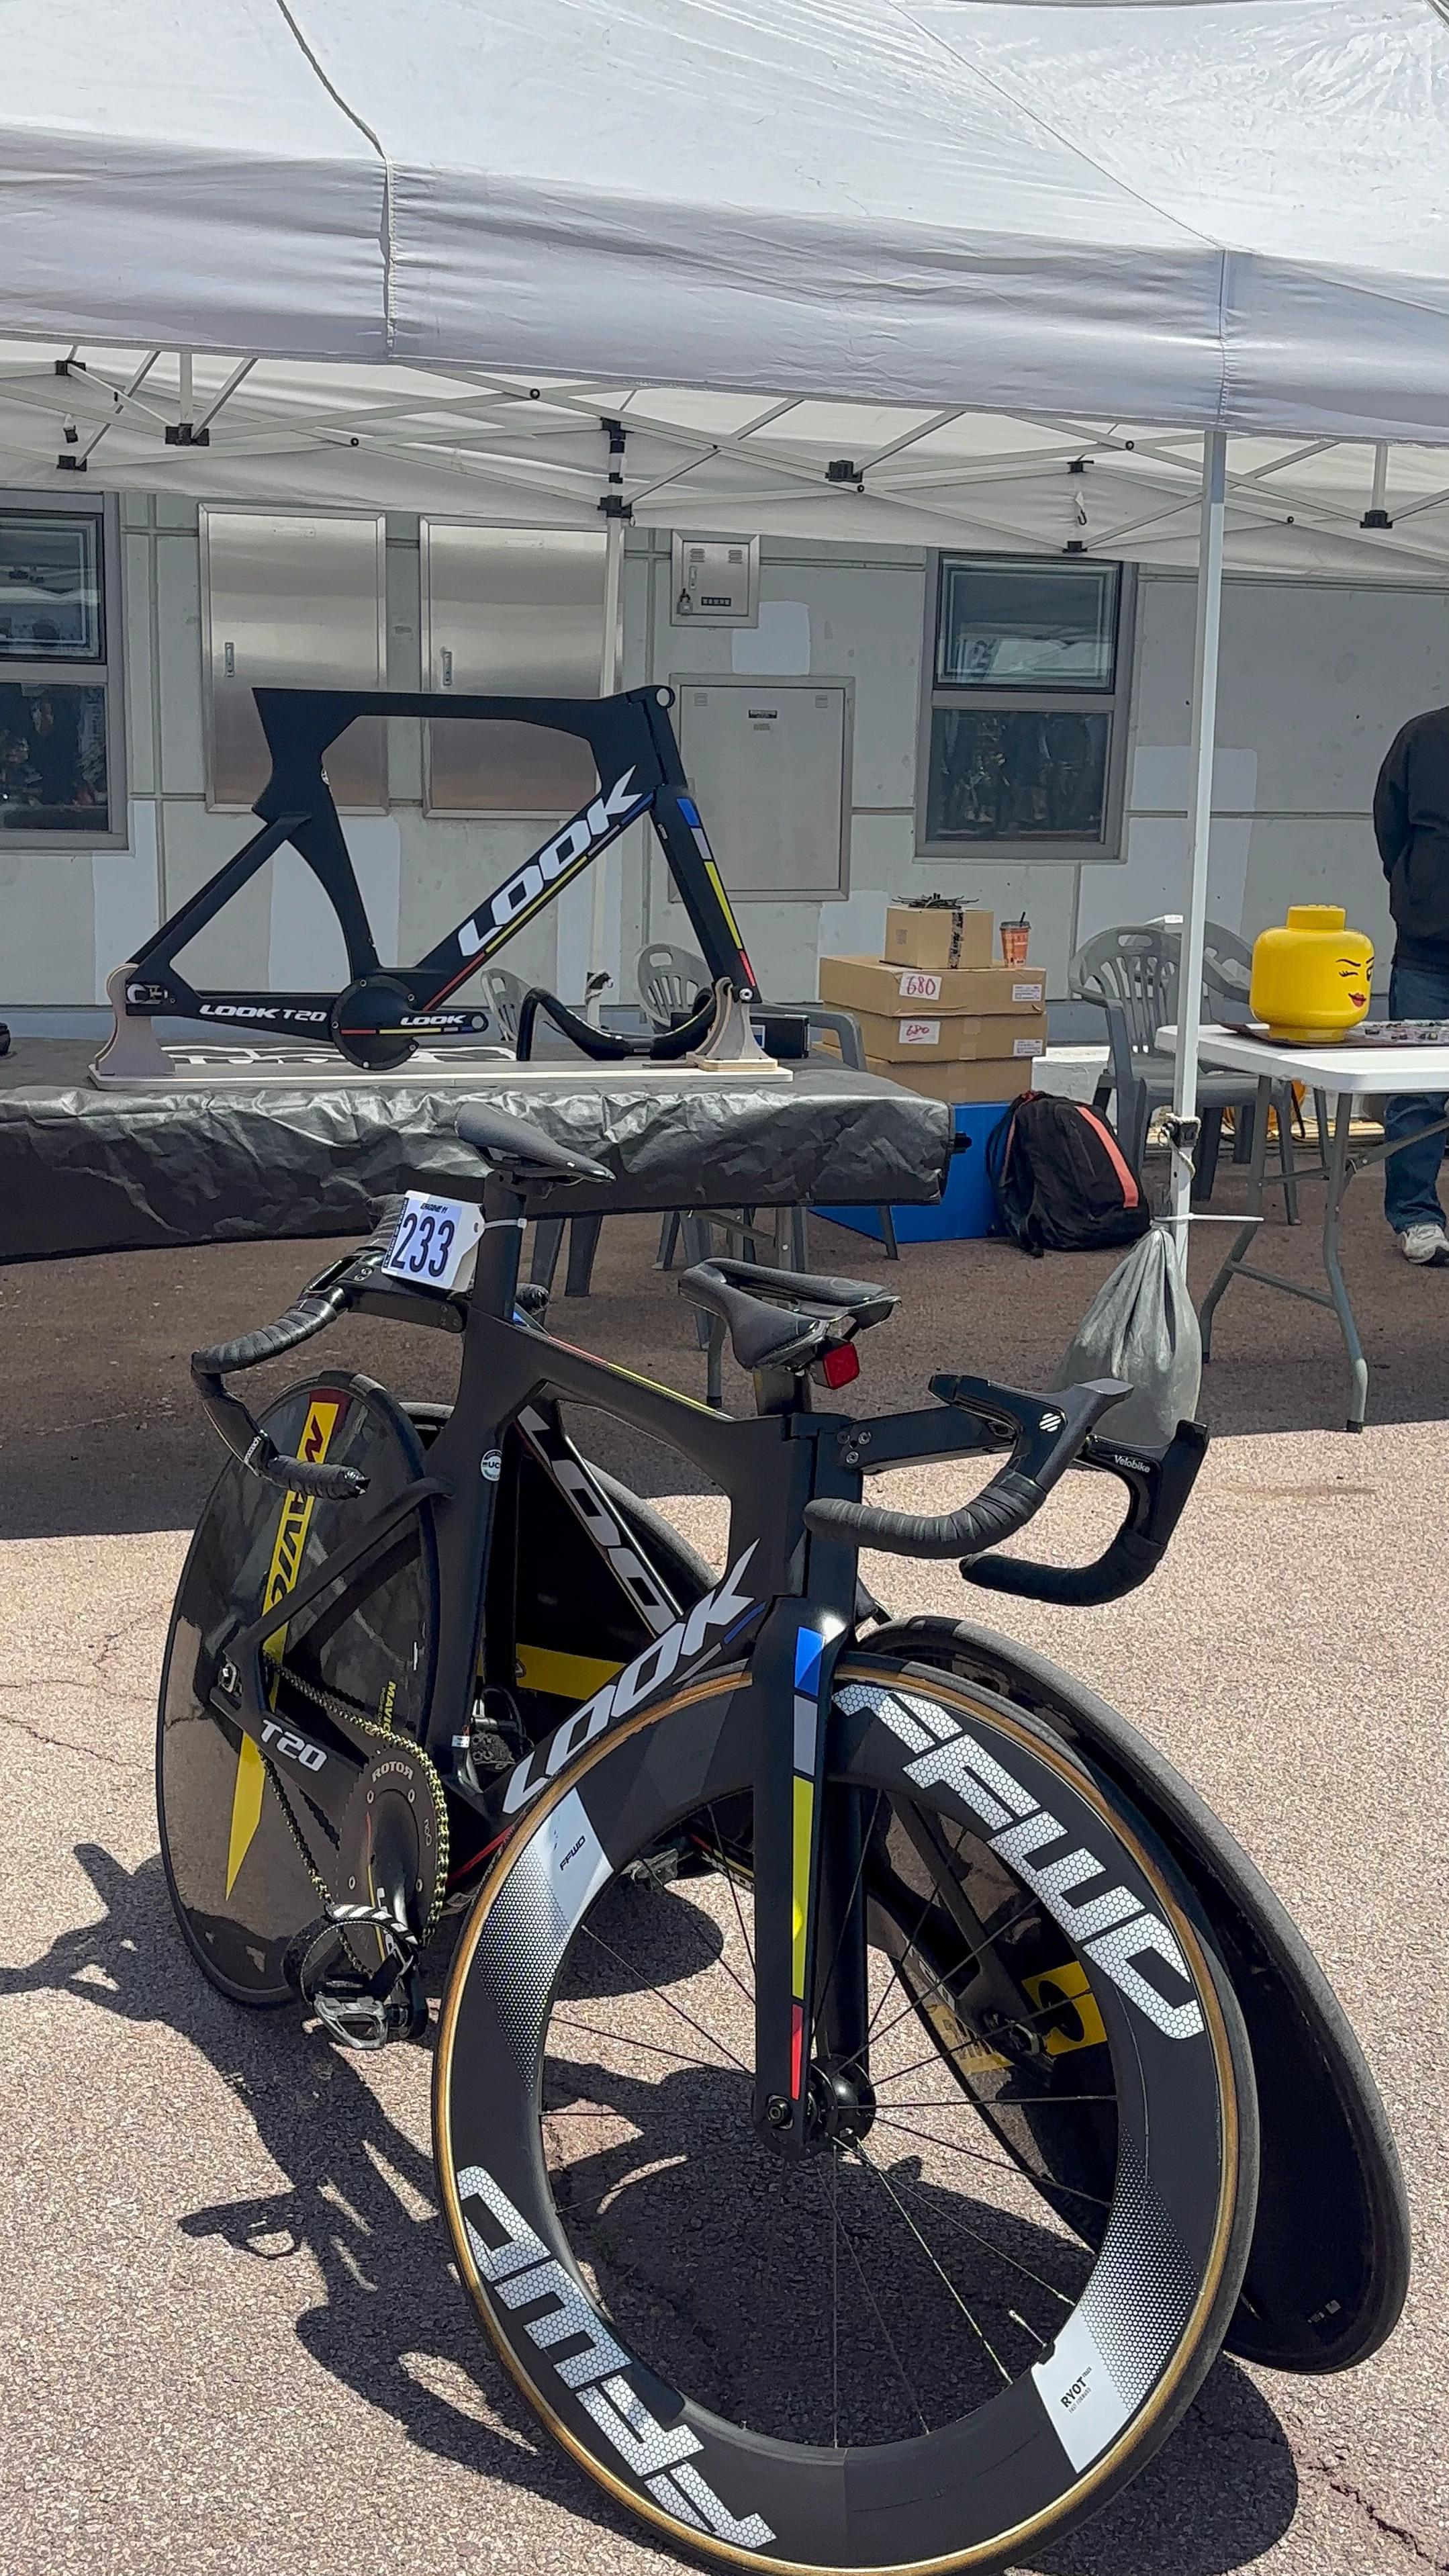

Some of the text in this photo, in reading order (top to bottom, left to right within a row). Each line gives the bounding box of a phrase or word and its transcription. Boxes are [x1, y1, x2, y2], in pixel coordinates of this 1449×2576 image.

[458, 764, 643, 957] LOOK
[907, 976, 936, 997] 680
[199, 1005, 328, 1023] LOOK T20
[400, 1014, 467, 1026] LOOK
[390, 1213, 455, 1277] 233
[1115, 1455, 1150, 1473] Velobike
[517, 1405, 677, 1635] LOO
[502, 1538, 760, 1814] LOOK
[383, 1680, 397, 1733] MAVIC
[261, 1719, 328, 1772] T20
[371, 1761, 414, 1783] ROTOR
[560, 1835, 586, 1872] FFWD
[831, 1684, 1205, 2039] FFWD
[1060, 2376, 1086, 2408] RYOT
